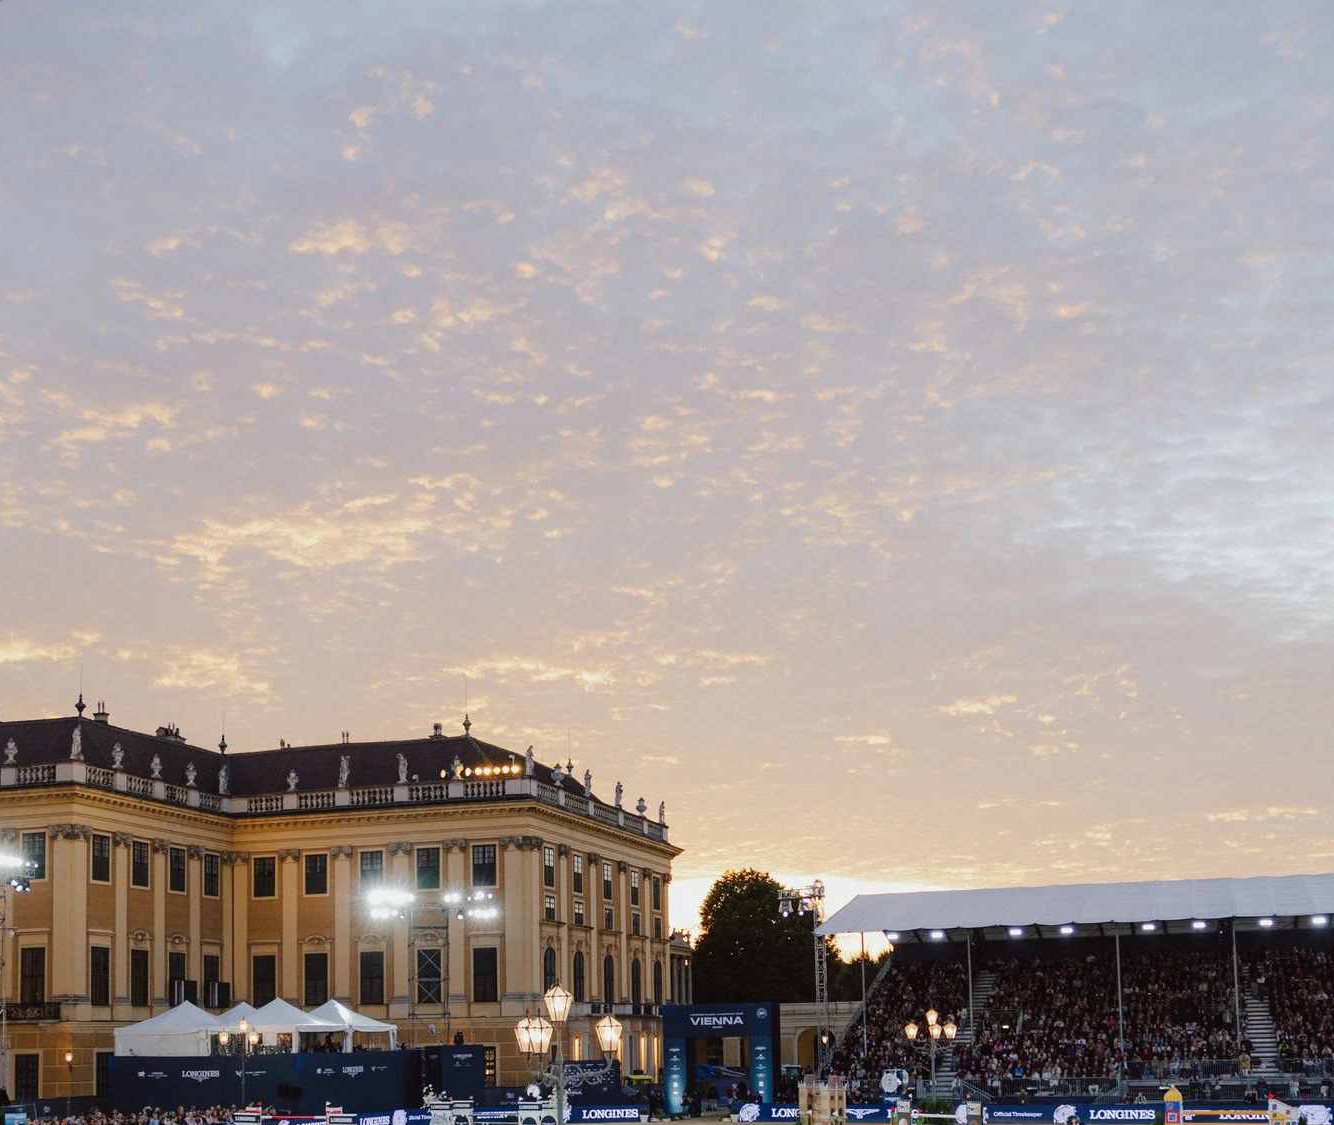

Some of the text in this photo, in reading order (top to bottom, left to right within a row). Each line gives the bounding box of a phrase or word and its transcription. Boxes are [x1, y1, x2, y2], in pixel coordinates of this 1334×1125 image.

[690, 1016, 744, 1026] VIENNA
[181, 1070, 220, 1078] LONGINES
[582, 1108, 639, 1119] LONGINES
[1012, 1111, 1043, 1119] Timekeeper
[1089, 1109, 1156, 1120] LONGINES
